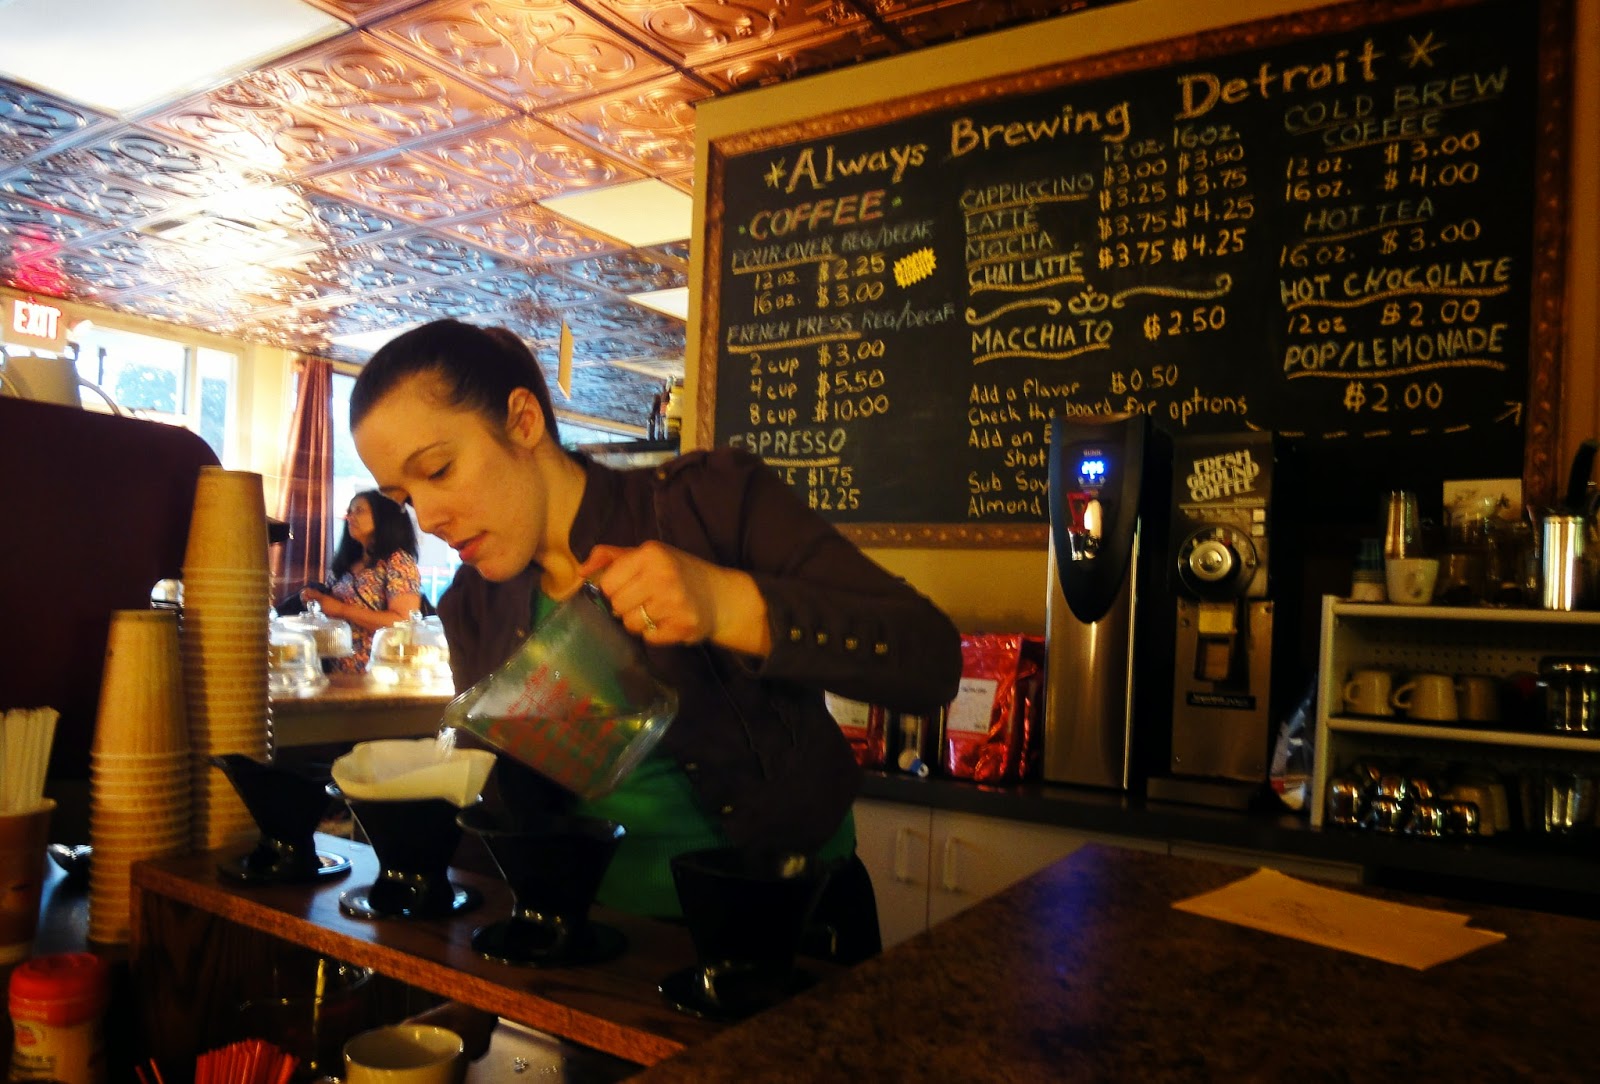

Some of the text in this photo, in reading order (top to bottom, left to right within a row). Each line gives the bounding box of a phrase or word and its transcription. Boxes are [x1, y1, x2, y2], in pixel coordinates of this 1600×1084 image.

[1284, 66, 1508, 134] COLD BREW
[785, 38, 1386, 193] Always Brewing Detroit
[1323, 112, 1441, 147] COFFEE
[960, 172, 1094, 211] CAPPUCCINO
[749, 189, 887, 240] COFFEE
[1304, 196, 1433, 232] HOT TEA
[965, 230, 1054, 264] MOCHA
[968, 262, 1015, 287] CHAI
[1280, 256, 1512, 305] HOT CHOCOLATE
[13, 299, 62, 340] EXIT
[727, 320, 790, 343] FRENCH
[796, 313, 853, 336] PRESS
[971, 319, 1113, 353] MACCHIATO
[1283, 322, 1508, 372] POP/LEMONADE
[750, 353, 762, 375] 2
[767, 356, 800, 378] cup
[750, 378, 763, 399] 4
[766, 381, 798, 400] cup
[969, 382, 999, 405] Add
[1006, 387, 1018, 400] a
[750, 402, 761, 426] 8
[766, 407, 798, 425] cup
[968, 402, 1022, 427] Check
[1029, 401, 1057, 421] the
[1065, 397, 1113, 417] board
[1169, 386, 1248, 427] options
[729, 427, 847, 456] ESPRESSO
[969, 426, 1003, 449] Add
[1011, 428, 1034, 447] an
[1003, 447, 1047, 468] Shot
[1193, 449, 1251, 475] FRESH
[969, 469, 1050, 496] Sub Soy
[1186, 461, 1260, 491] GROUND
[1190, 478, 1257, 502] COFFEE
[968, 495, 1042, 519] Almond
